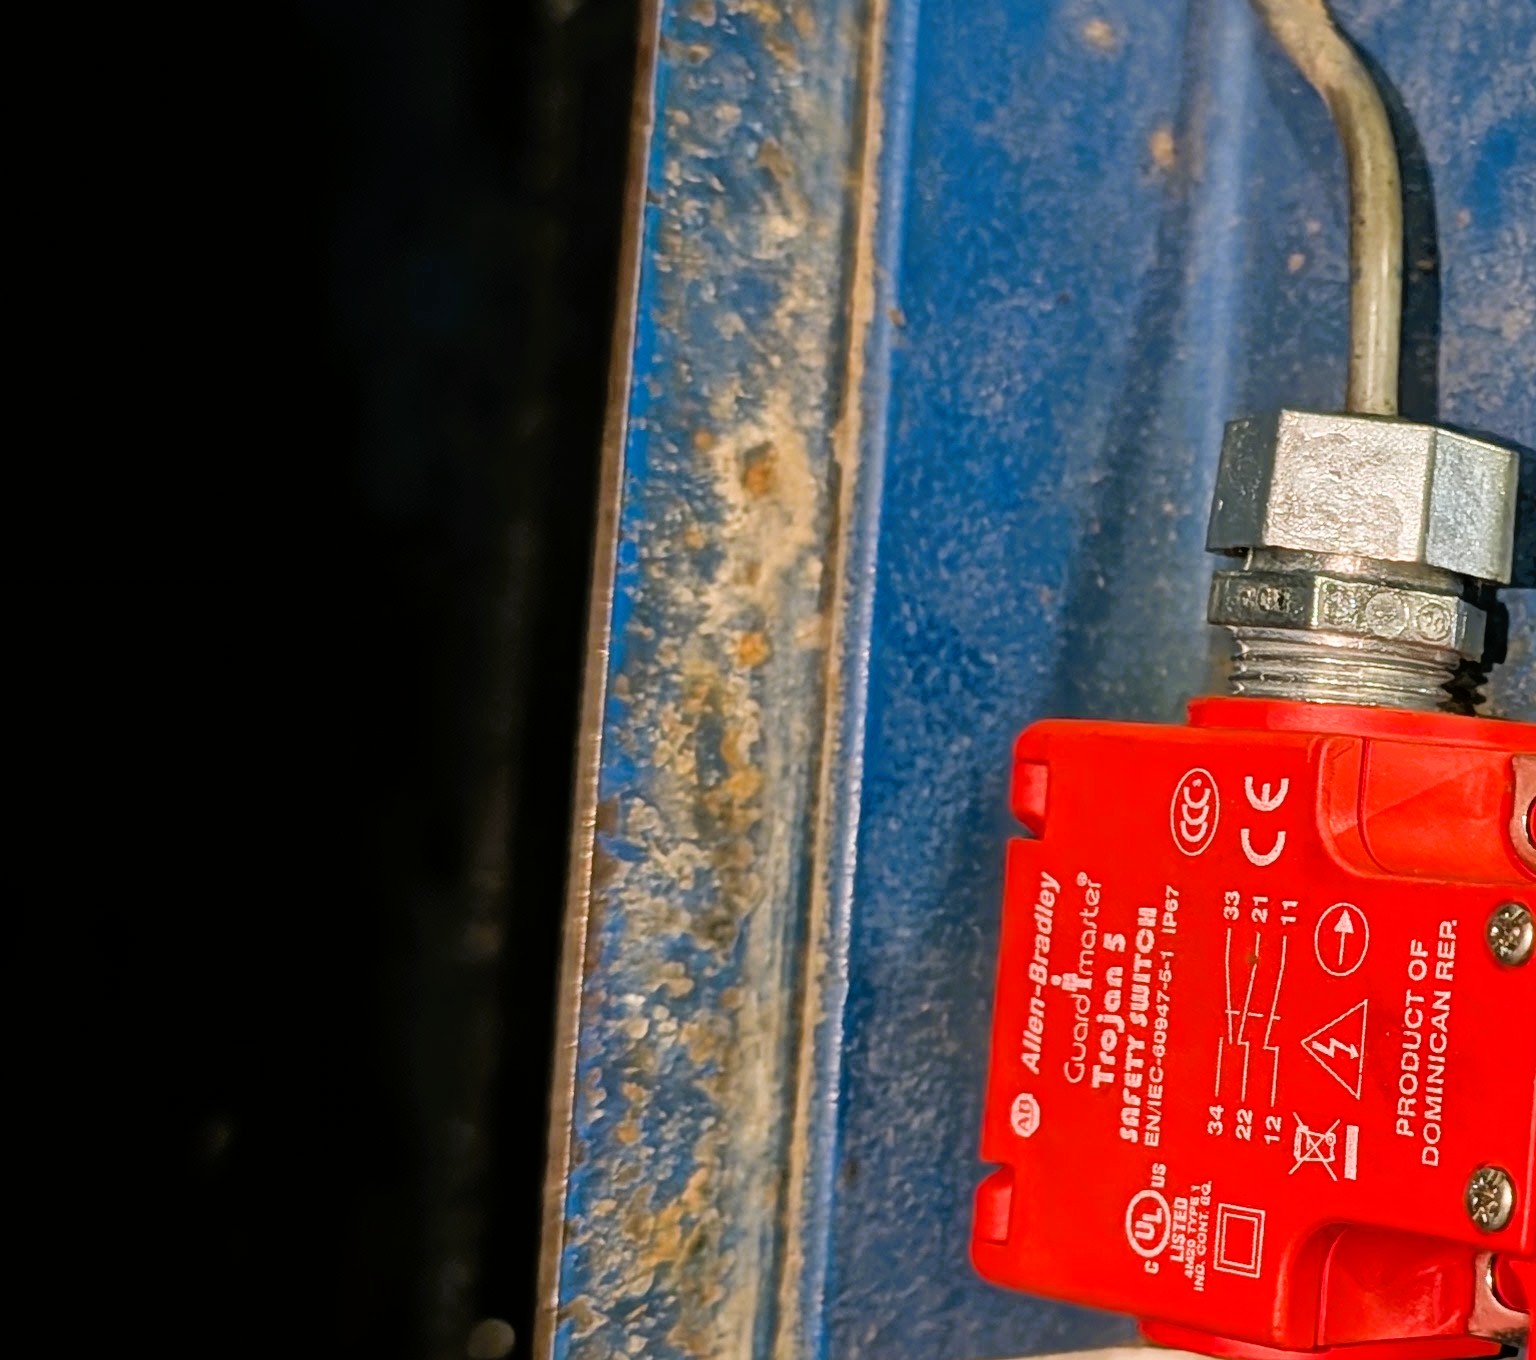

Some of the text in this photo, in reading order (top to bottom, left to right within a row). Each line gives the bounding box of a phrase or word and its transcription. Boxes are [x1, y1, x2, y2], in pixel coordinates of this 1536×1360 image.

[1240, 775, 1289, 866] CE
[1161, 885, 1180, 934] IP67
[1223, 890, 1241, 921] 33
[1251, 896, 1269, 924] 21
[1280, 900, 1298, 926] 11
[1020, 871, 1061, 1075] Allen-Bradley
[1091, 933, 1126, 1088] Trojan 5
[1120, 907, 1158, 1143] SAFETY SWITCH
[1396, 939, 1429, 1137] PRODUCT OF
[1421, 990, 1452, 1167] DOMINICAN
[1207, 1104, 1225, 1136] 34
[1235, 1109, 1253, 1141] 22
[1264, 1115, 1282, 1144] 12
[1135, 1207, 1163, 1241] UL
[1151, 1163, 1167, 1189] US
[1170, 1196, 1189, 1262] LISTED
[1187, 1195, 1200, 1234] TYPE
